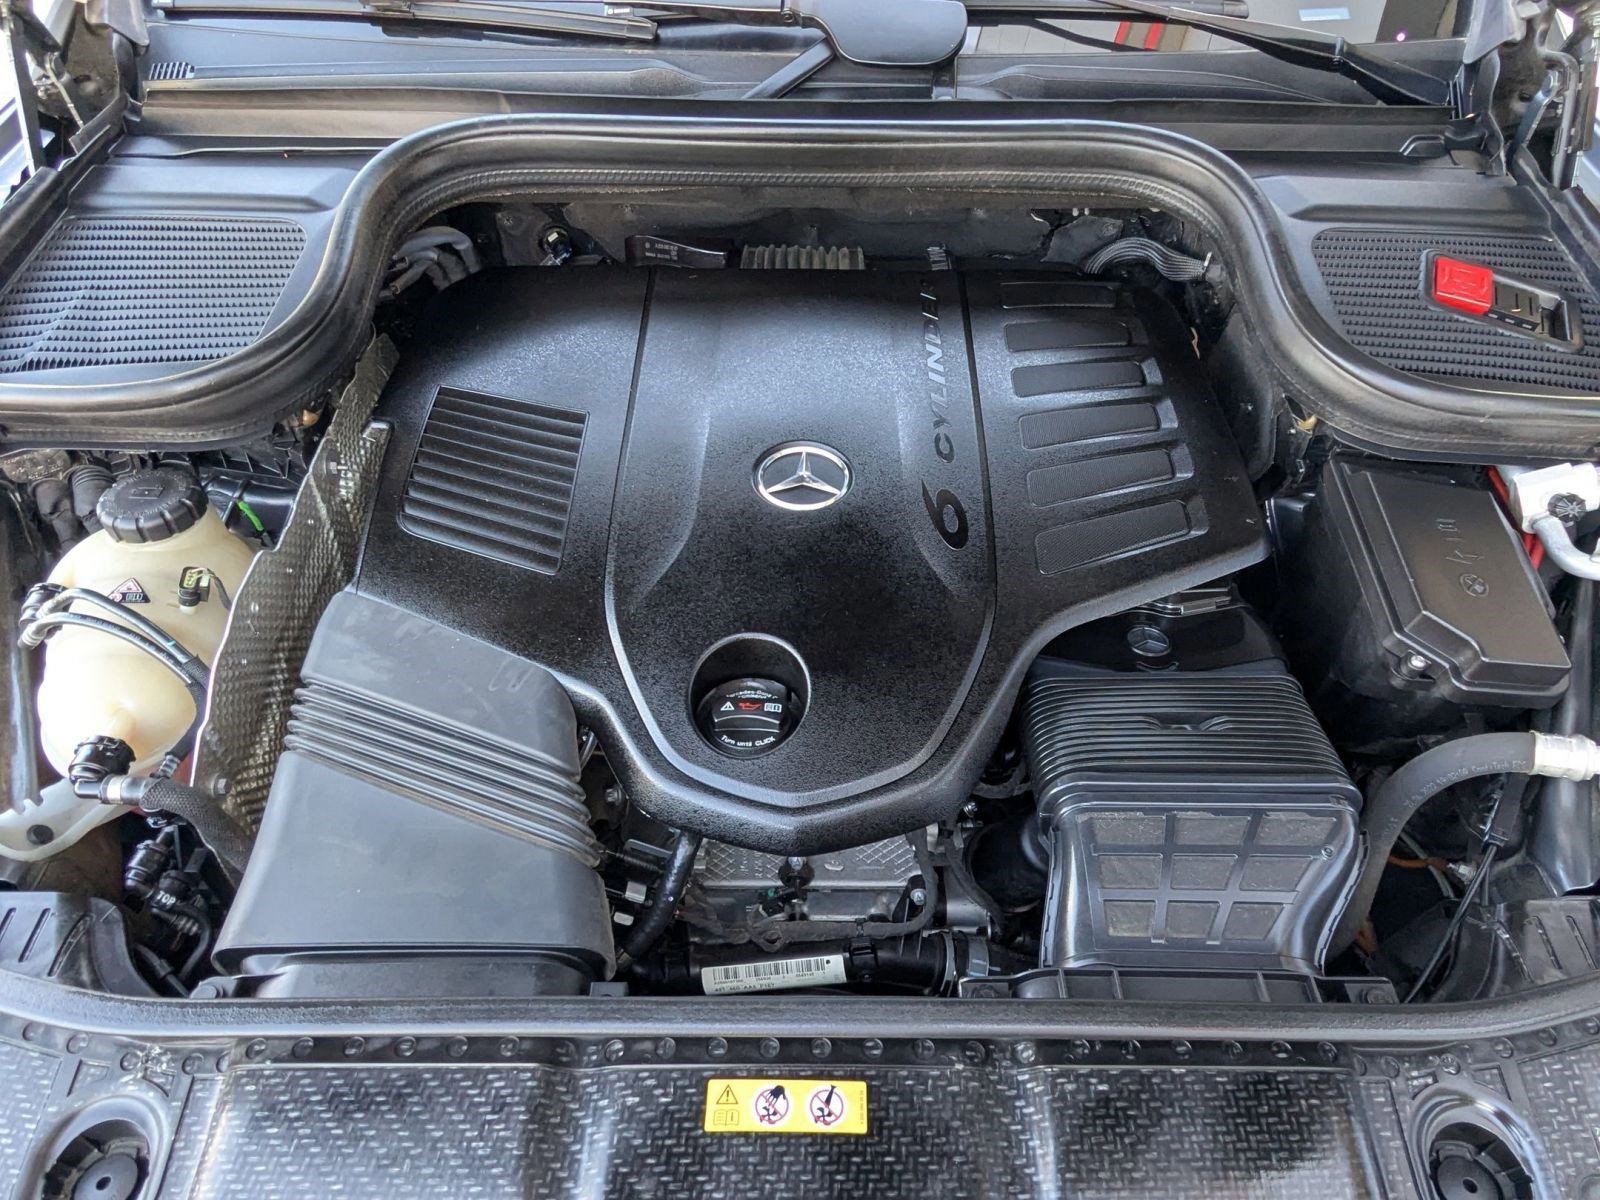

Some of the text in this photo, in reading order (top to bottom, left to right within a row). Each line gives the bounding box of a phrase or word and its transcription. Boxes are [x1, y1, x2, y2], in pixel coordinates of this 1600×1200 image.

[920, 478, 969, 550] 6
[721, 735, 736, 745] Turn
[754, 735, 776, 746] CLICK
[156, 890, 177, 905] TOP
